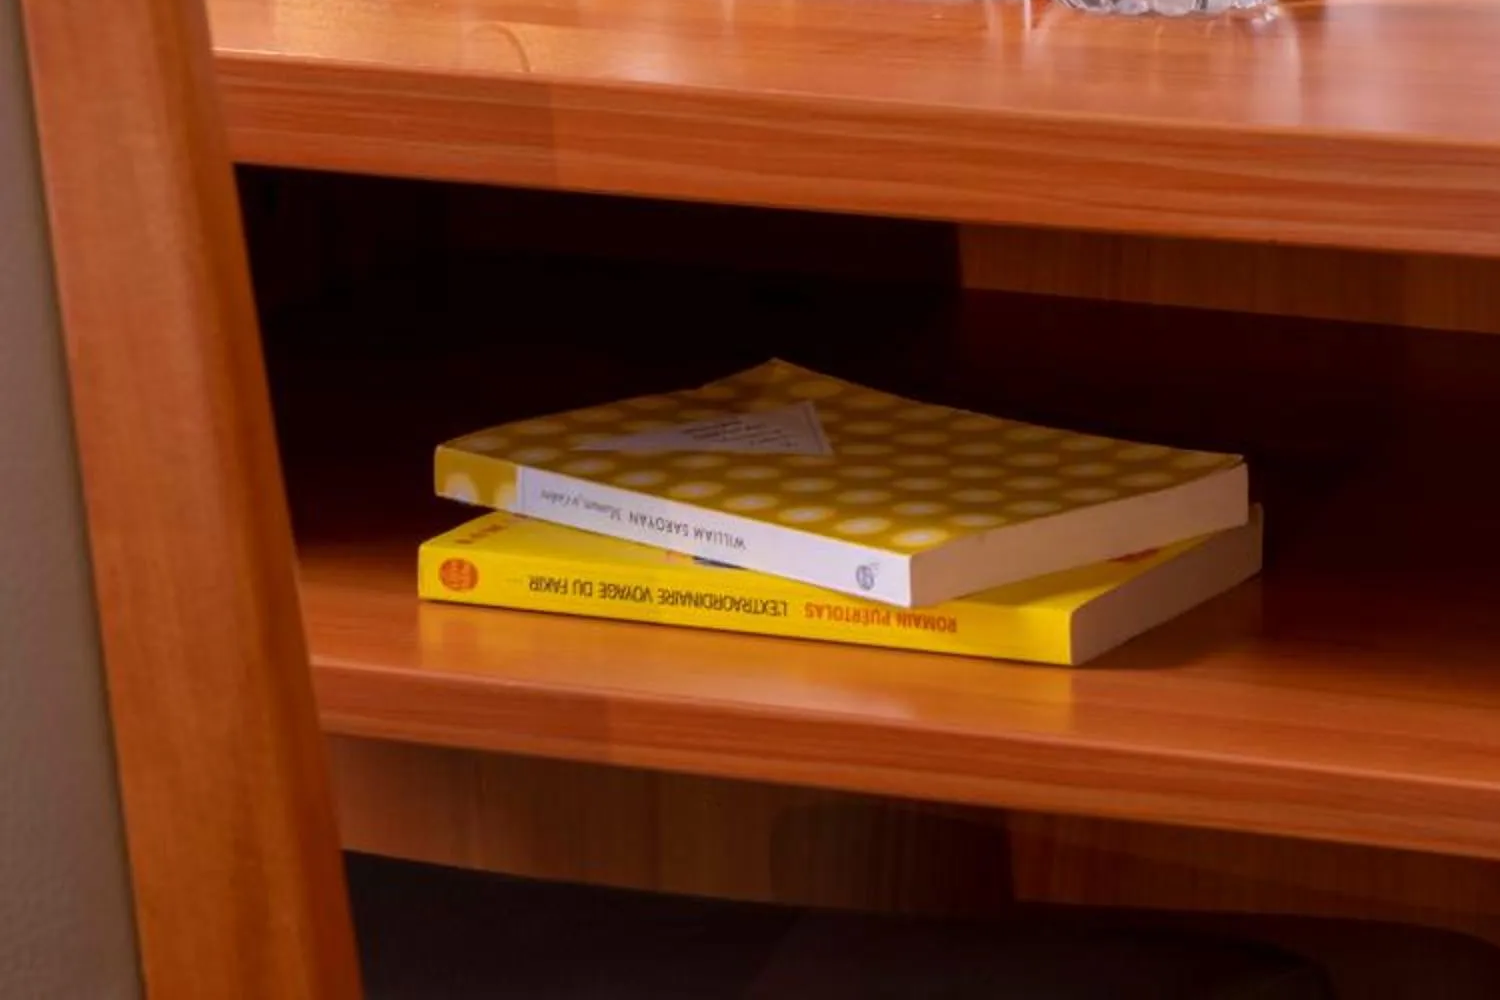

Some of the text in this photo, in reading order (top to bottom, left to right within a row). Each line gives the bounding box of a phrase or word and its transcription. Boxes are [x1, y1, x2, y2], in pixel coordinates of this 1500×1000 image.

[628, 511, 689, 537] SAROYAN
[693, 529, 747, 551] WILLIAM
[529, 574, 568, 595] FAKIR
[573, 578, 593, 597] DU
[599, 581, 652, 604] VOYAGE
[657, 587, 788, 617] L'EXTRAORDINAIRE
[897, 612, 958, 633] ROMAIN
